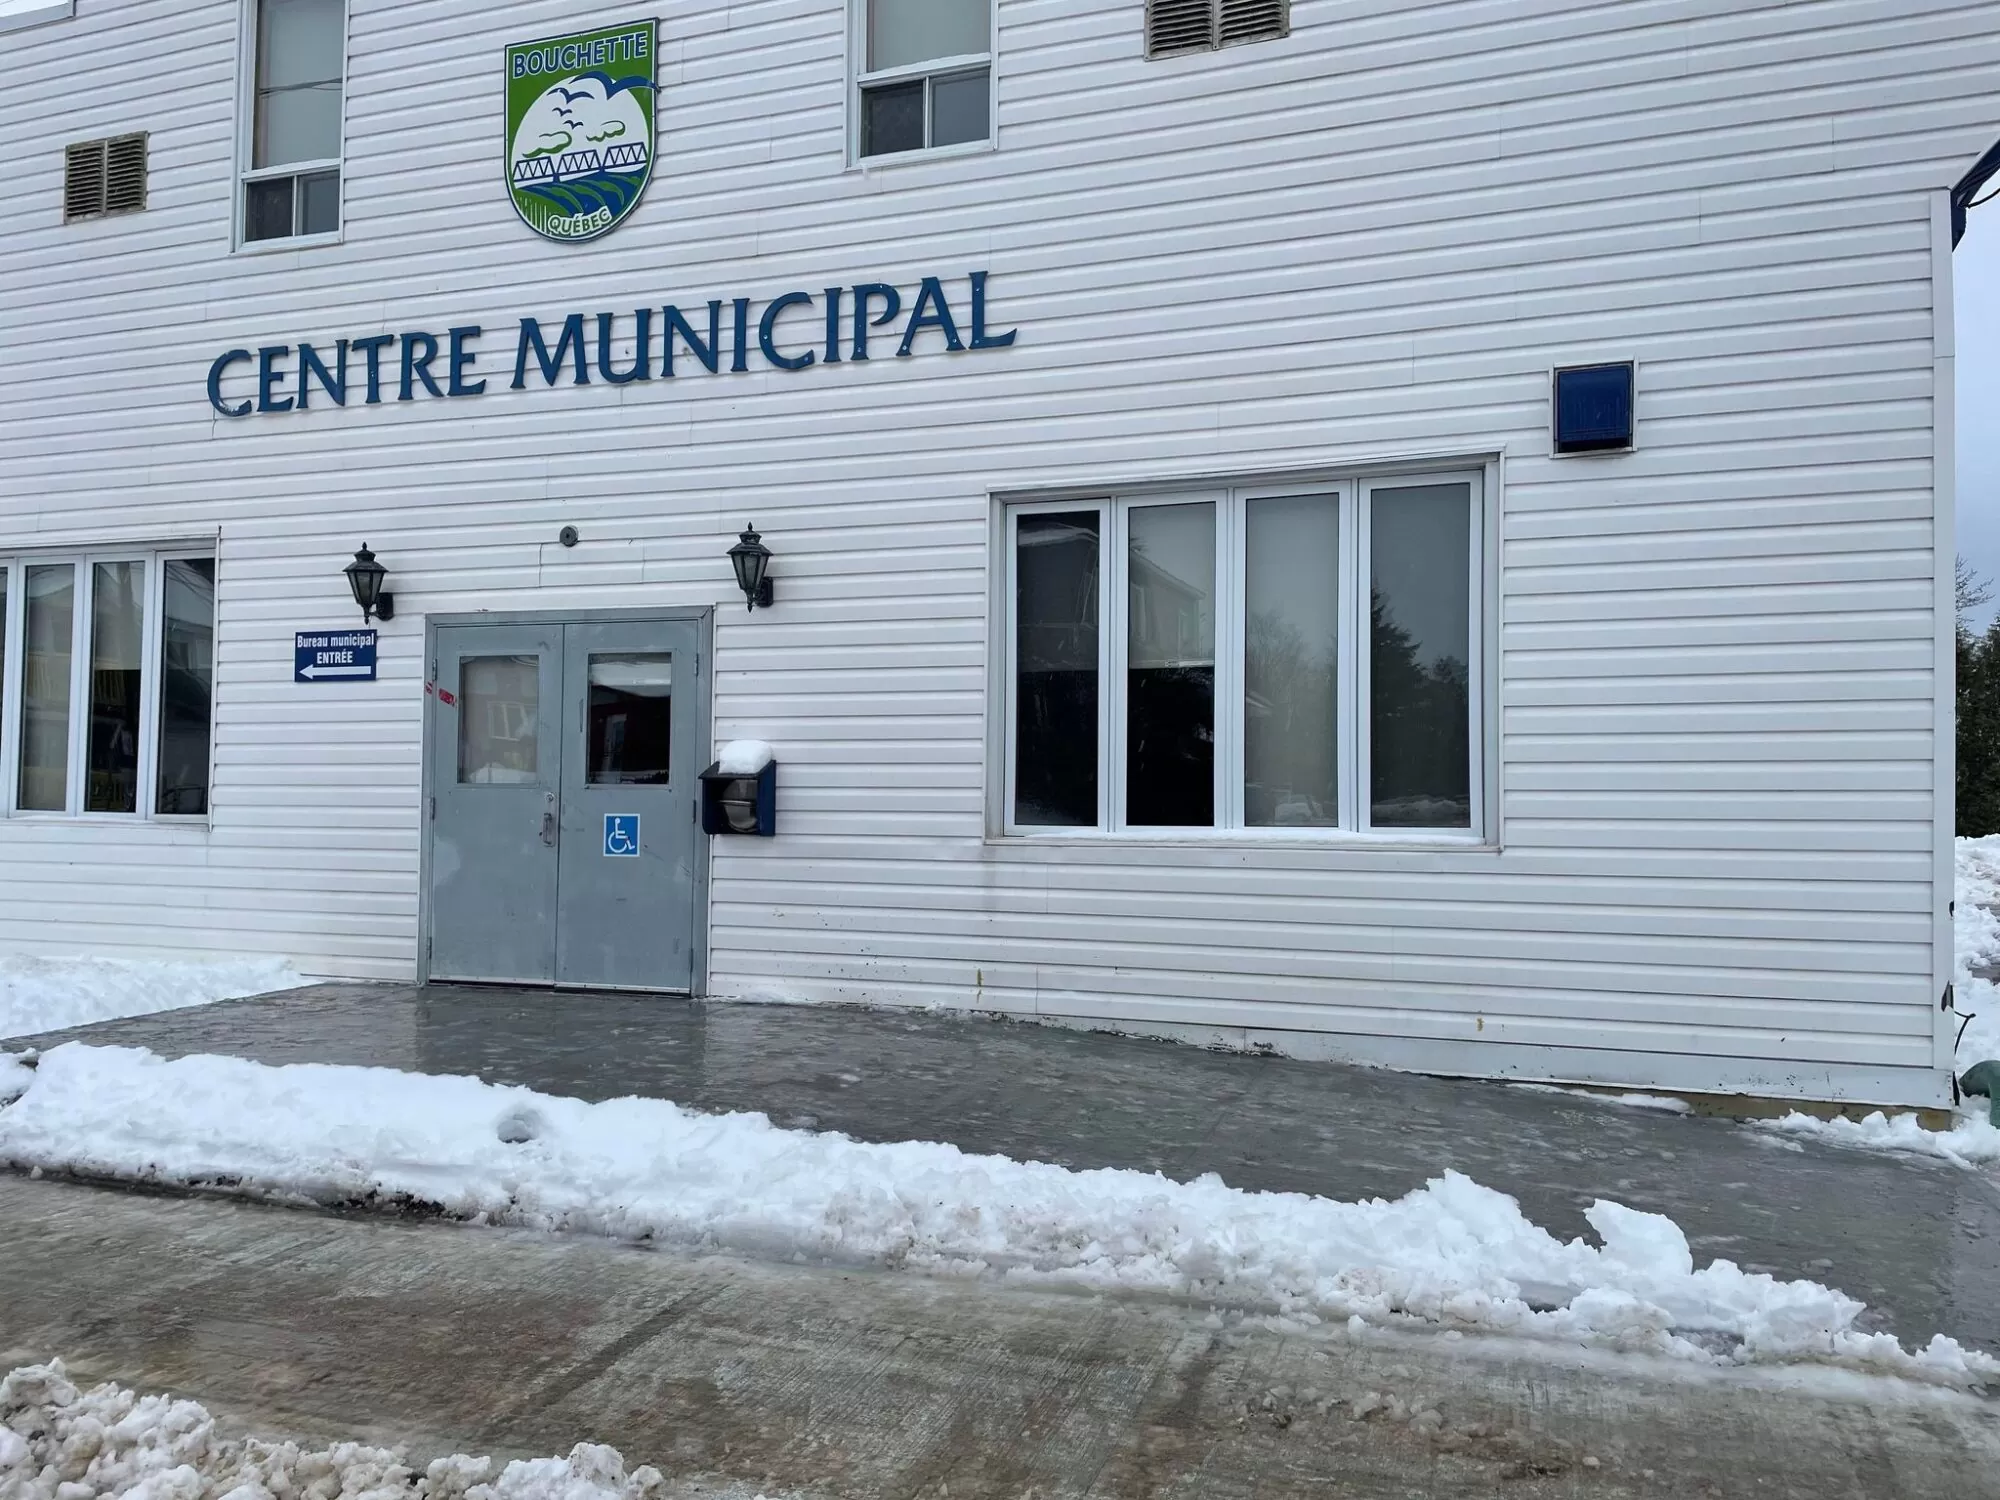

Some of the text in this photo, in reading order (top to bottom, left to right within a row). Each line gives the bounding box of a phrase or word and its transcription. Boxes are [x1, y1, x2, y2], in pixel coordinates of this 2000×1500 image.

[513, 31, 648, 78] BOUCHETTE
[549, 206, 612, 236] QUÉBEC
[207, 270, 1018, 417] CENTRE MUNICIPAL
[297, 632, 375, 649] Bureau municipal
[316, 648, 354, 664] ENTRÉE
